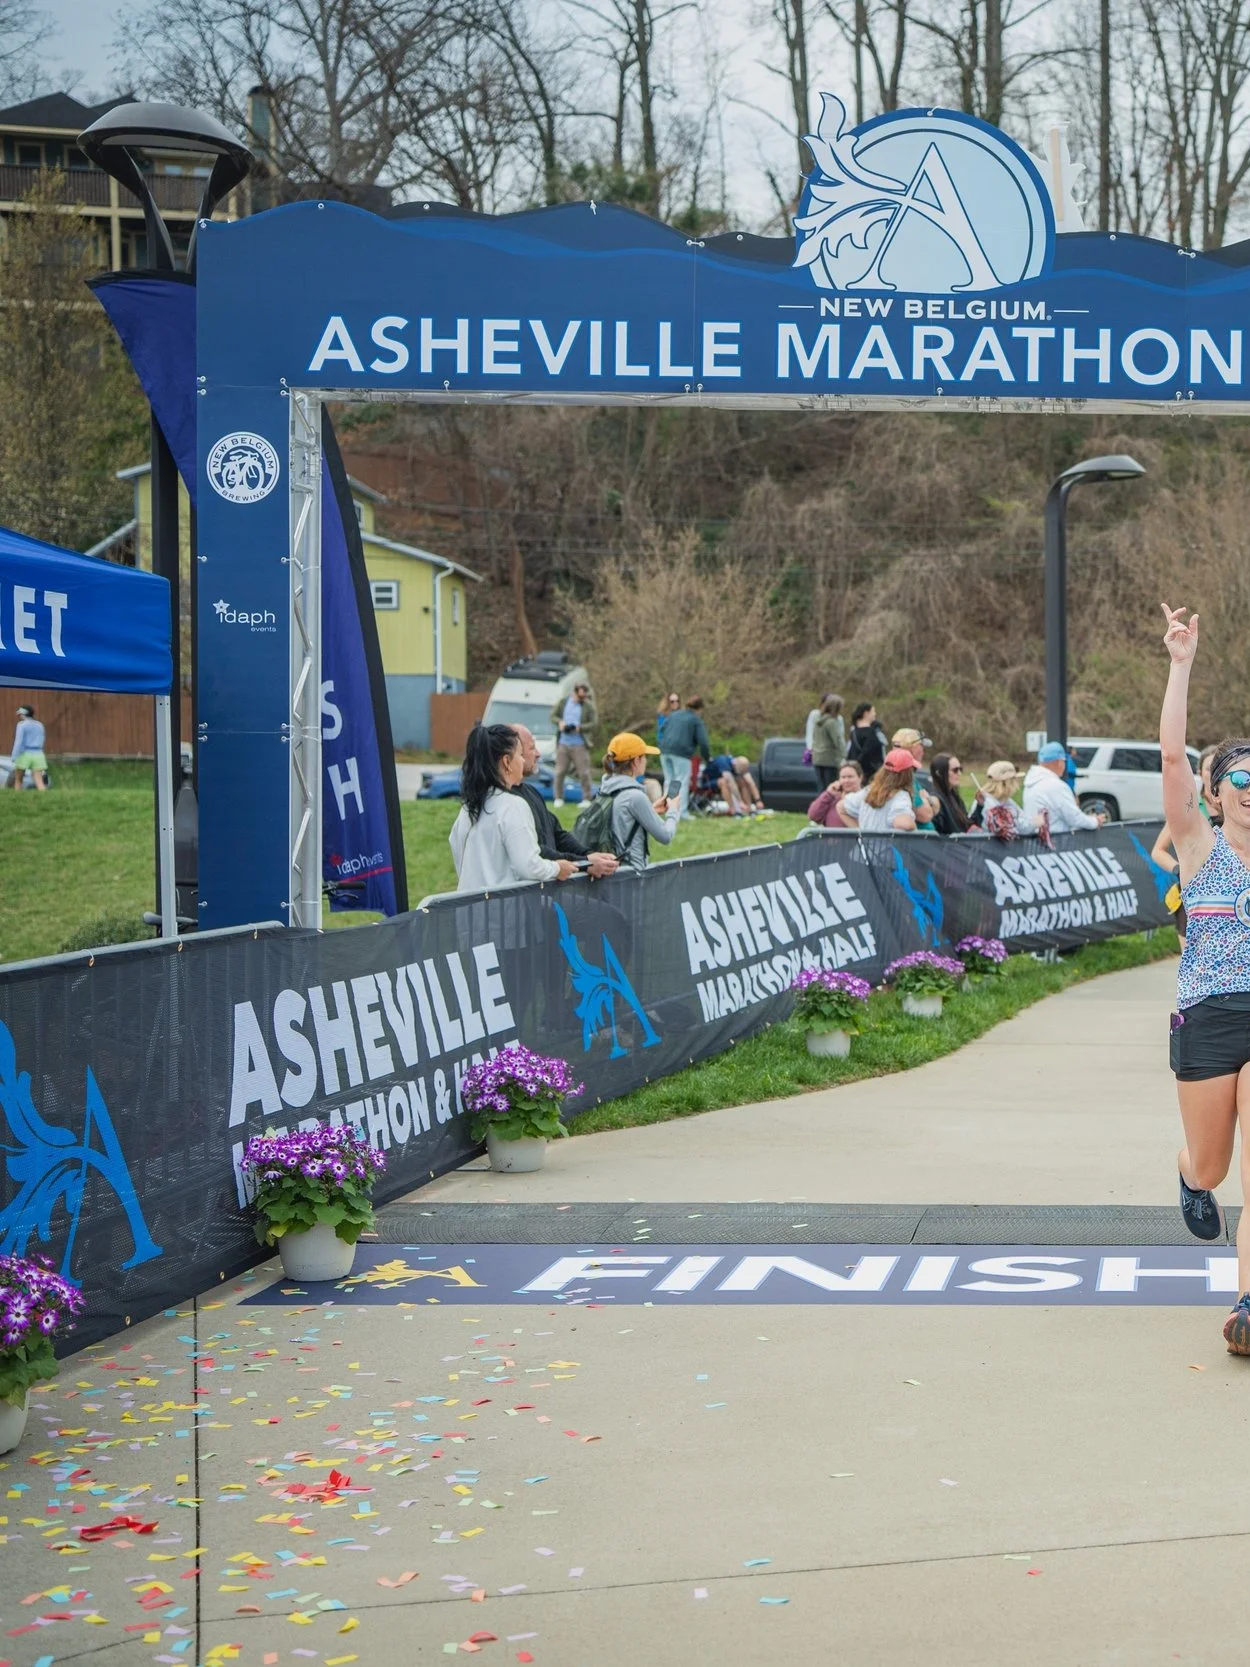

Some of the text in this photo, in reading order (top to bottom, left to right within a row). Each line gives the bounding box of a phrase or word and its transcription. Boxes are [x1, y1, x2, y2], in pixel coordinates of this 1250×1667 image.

[820, 297, 1047, 320] NEW BELGIUM
[308, 315, 742, 378] ASHEVILLE
[777, 323, 1243, 386] MARATHON
[212, 437, 274, 470] NEW BELGIUM
[221, 489, 266, 501] BREWING
[0, 585, 68, 658] ET
[217, 604, 276, 626] idaph
[985, 847, 1132, 906] ASHEVILLE
[681, 862, 867, 975] ASHEVILLE
[999, 888, 1139, 939] MARATHON & HALF
[696, 948, 801, 1023] MARATHON
[819, 922, 877, 970] HALF
[229, 942, 516, 1127] ASHEVILLE
[433, 1068, 453, 1124] &
[519, 1255, 1240, 1292] FINISH
